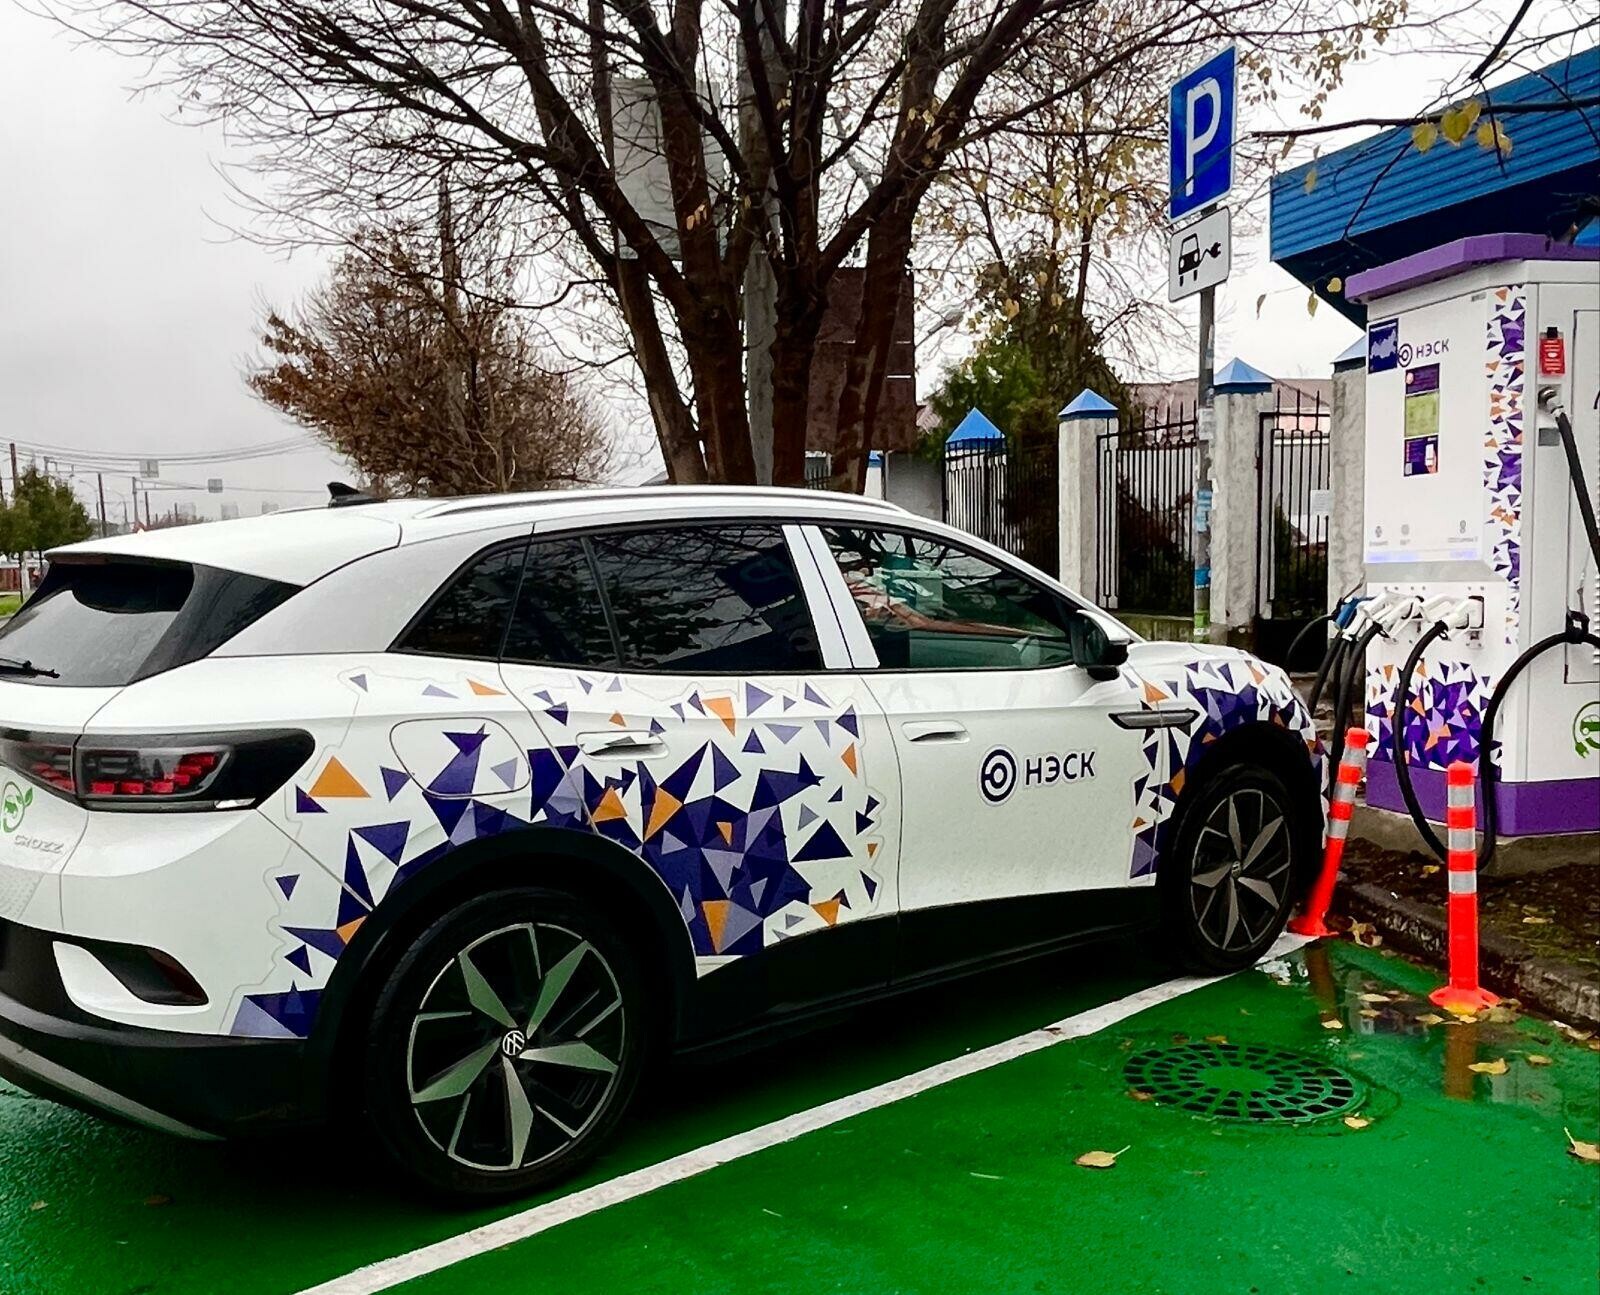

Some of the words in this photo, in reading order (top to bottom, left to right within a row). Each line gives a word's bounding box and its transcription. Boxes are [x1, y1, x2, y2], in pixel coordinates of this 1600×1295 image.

[1186, 77, 1222, 197] P
[1416, 338, 1450, 359] НЭСК
[1025, 751, 1096, 786] НЭСК
